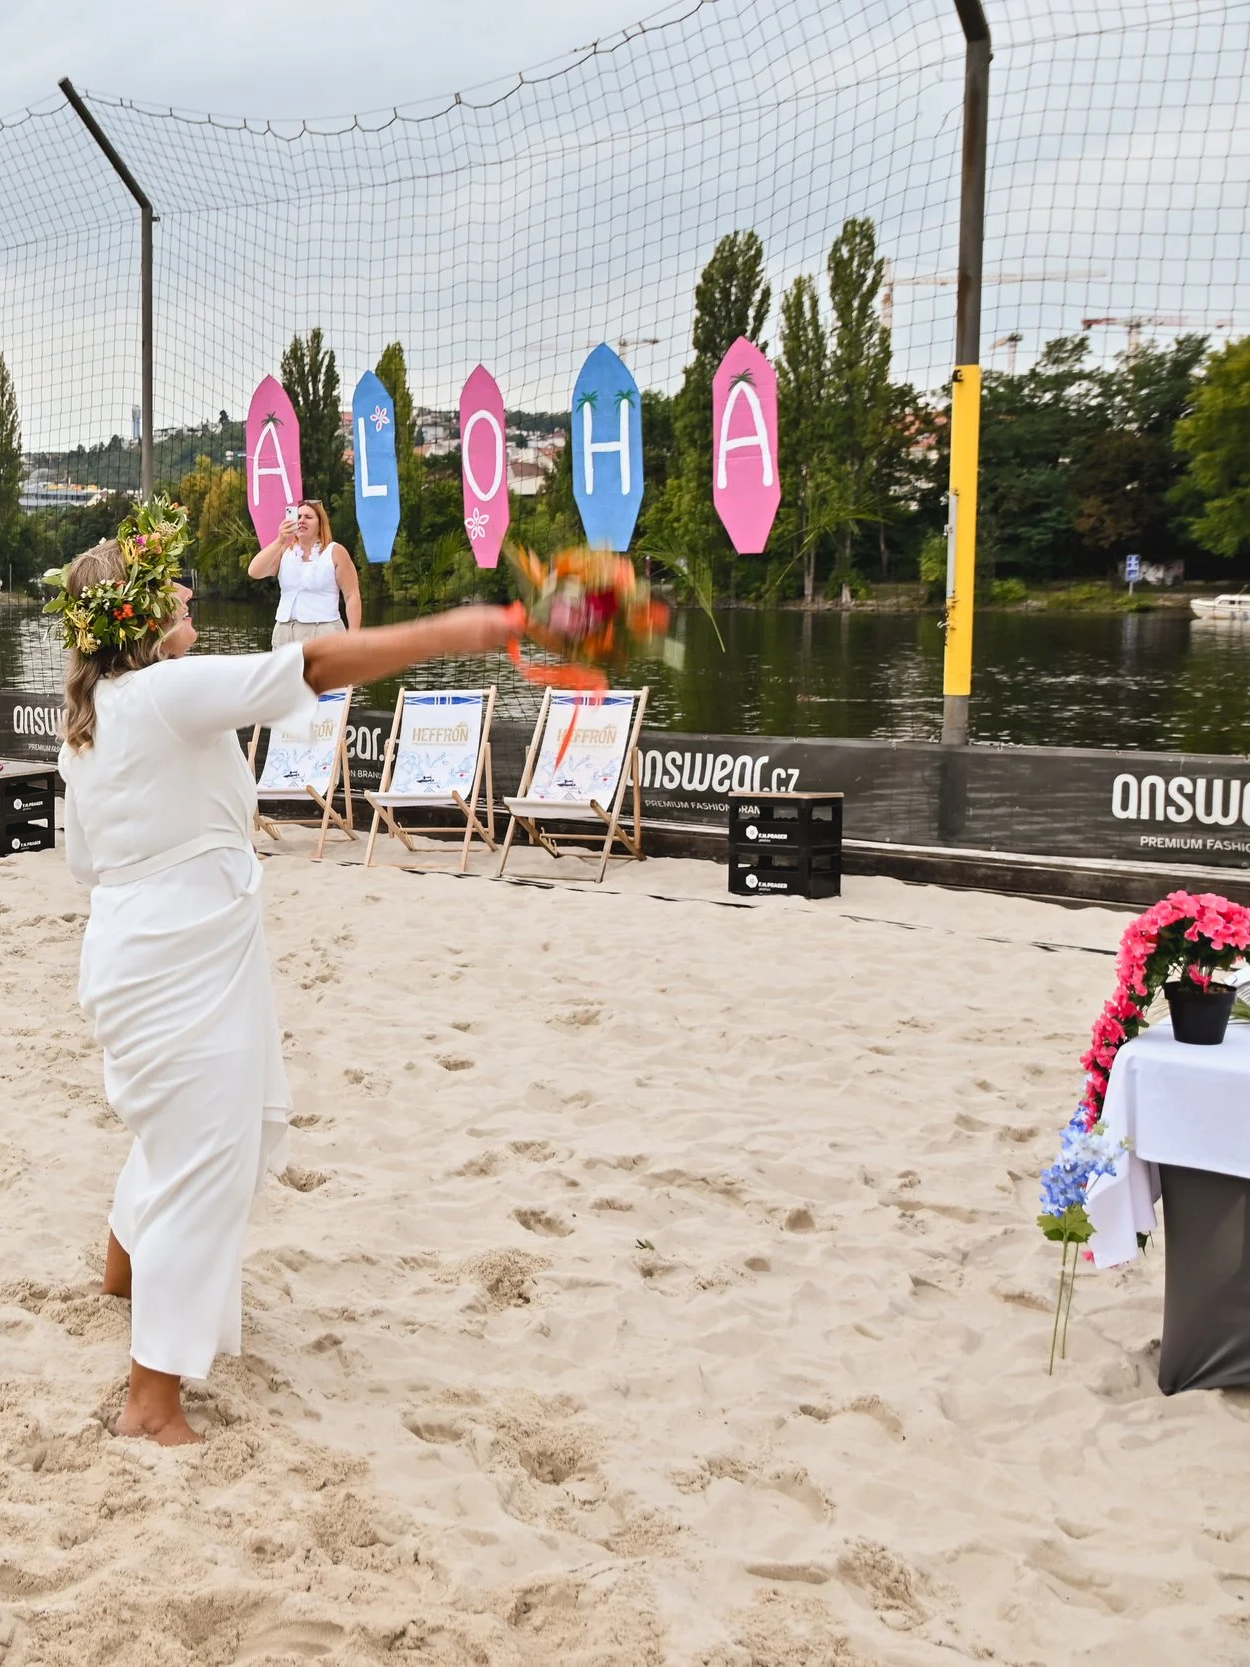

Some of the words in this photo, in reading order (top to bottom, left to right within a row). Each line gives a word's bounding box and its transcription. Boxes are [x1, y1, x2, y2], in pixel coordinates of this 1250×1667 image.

[412, 728, 469, 742] HEFFRON
[557, 728, 617, 744] HFFRON
[28, 744, 51, 752] PREMIUM
[645, 800, 690, 809] PREMIUM
[1112, 773, 1250, 826] answ
[1140, 836, 1203, 849] PREMIUM
